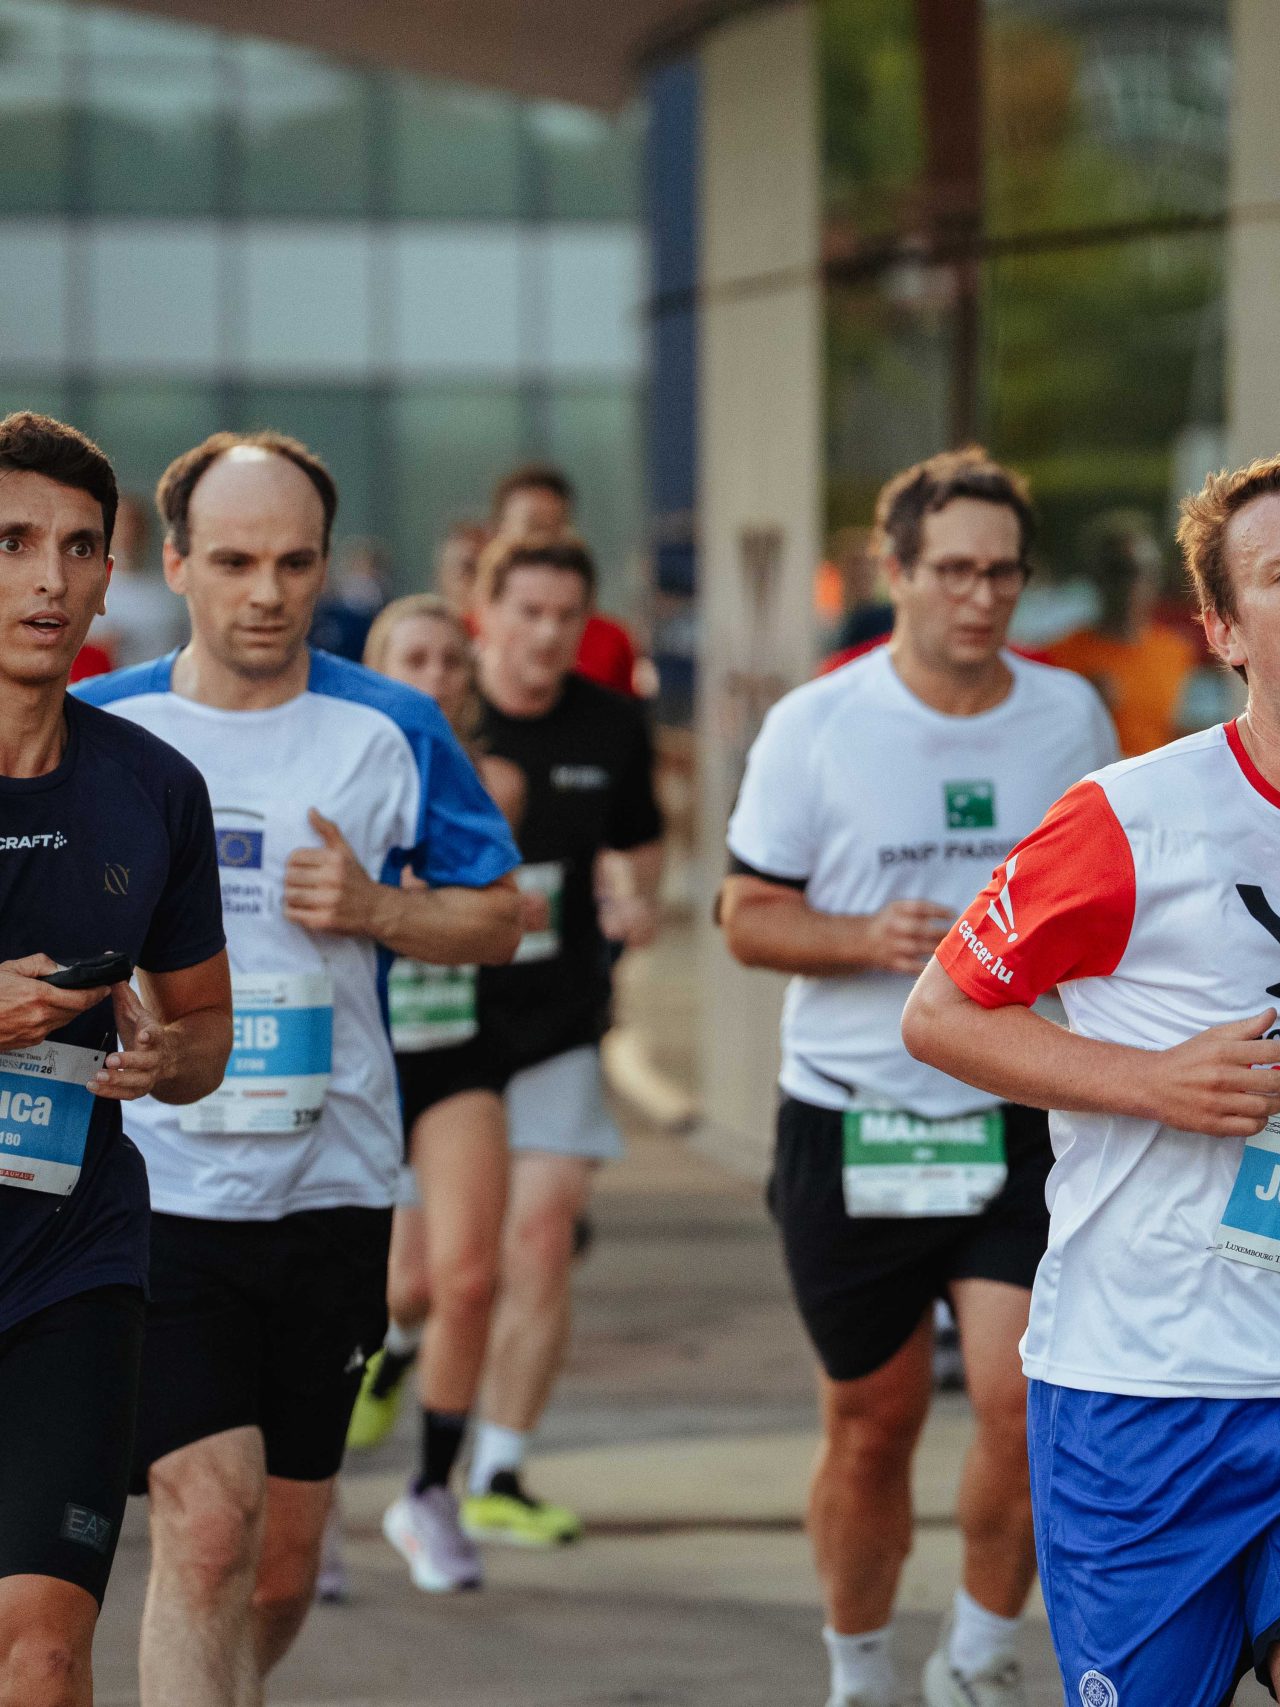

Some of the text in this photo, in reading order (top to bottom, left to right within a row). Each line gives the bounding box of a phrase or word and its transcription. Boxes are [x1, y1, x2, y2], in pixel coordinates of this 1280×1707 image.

[958, 920, 1014, 984] cancer.lu
[41, 1065, 52, 1074] 26
[1225, 1241, 1274, 1261] LUXEMBOURG
